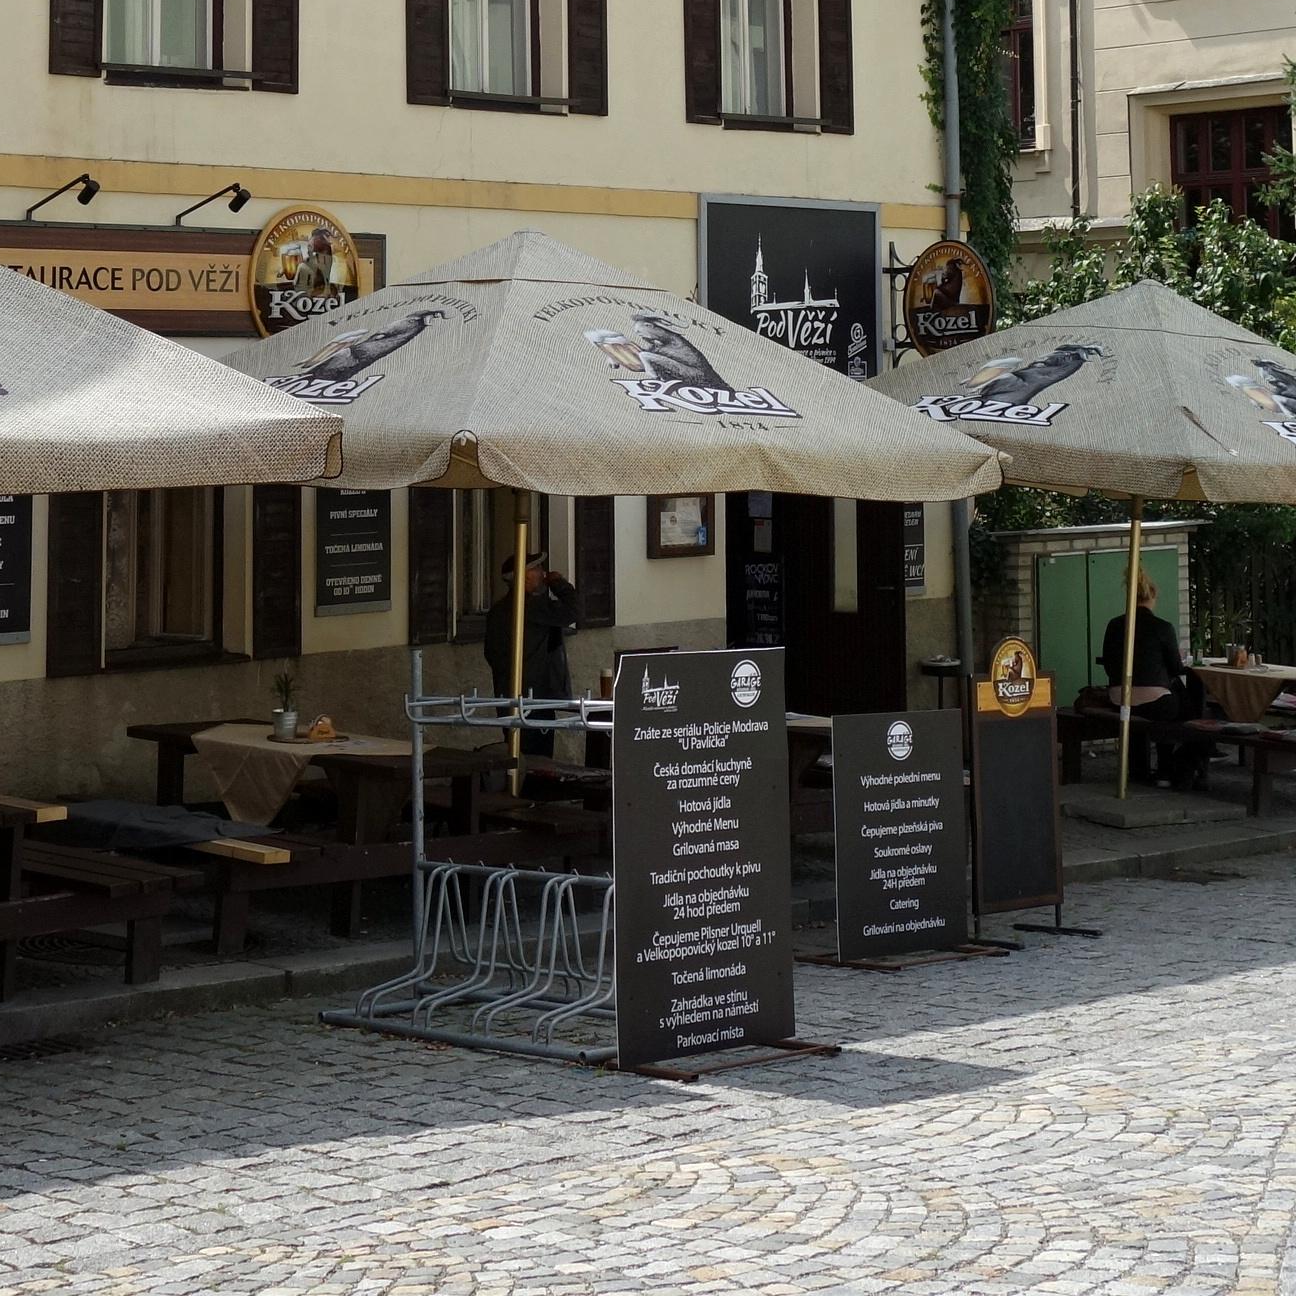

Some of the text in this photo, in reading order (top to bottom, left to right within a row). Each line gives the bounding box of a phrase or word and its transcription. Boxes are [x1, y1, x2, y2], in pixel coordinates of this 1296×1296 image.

[132, 267, 182, 292] POD
[188, 263, 241, 293] VĚŽÍ
[268, 290, 346, 321] Kozel
[756, 310, 786, 338] Pod
[787, 310, 837, 348] Věží
[916, 310, 979, 336] Kozel
[609, 378, 803, 419] Kozel
[913, 394, 1071, 427] Kozel
[731, 676, 762, 689] GARAGE
[998, 681, 1030, 697] Kozel
[656, 691, 679, 707] Věží
[634, 720, 769, 741] Znáte ze seriálu Policie Modrava
[654, 757, 752, 778] Česká domácí kuchyně
[666, 773, 740, 790] za rozumné ceny
[861, 772, 941, 789] Výhodné polední menu
[679, 796, 732, 813] Hotová jídla
[864, 799, 890, 812] Hotová
[911, 795, 940, 809] minutky
[672, 818, 739, 838] Výhodné Menu
[861, 820, 943, 839] Čepujeme plzeňská piva
[673, 840, 740, 856] Grilovaná masa
[874, 842, 933, 859] Soukromé oslavy
[650, 860, 761, 885] Tradiční pochoutky k pivu
[869, 862, 937, 881] Jídla na objednávku
[883, 877, 926, 891] 24H předem
[663, 884, 750, 908] Jídla na objednávku
[890, 897, 920, 910] Catering
[673, 901, 741, 920] 24 hod předem
[652, 919, 762, 948] Čepujeme Pilsner Urquell
[863, 916, 946, 937] Grilování na objednávku
[636, 952, 643, 963] a
[644, 942, 716, 962] Velkopopovický
[717, 937, 740, 951] kozel
[755, 935, 761, 946] a
[672, 962, 747, 985] Točená limonáda
[671, 990, 748, 1013] Zahrádka ve stínu
[659, 1000, 759, 1030] s výhledem na náměstí
[677, 1026, 744, 1048] Parkovací místa
